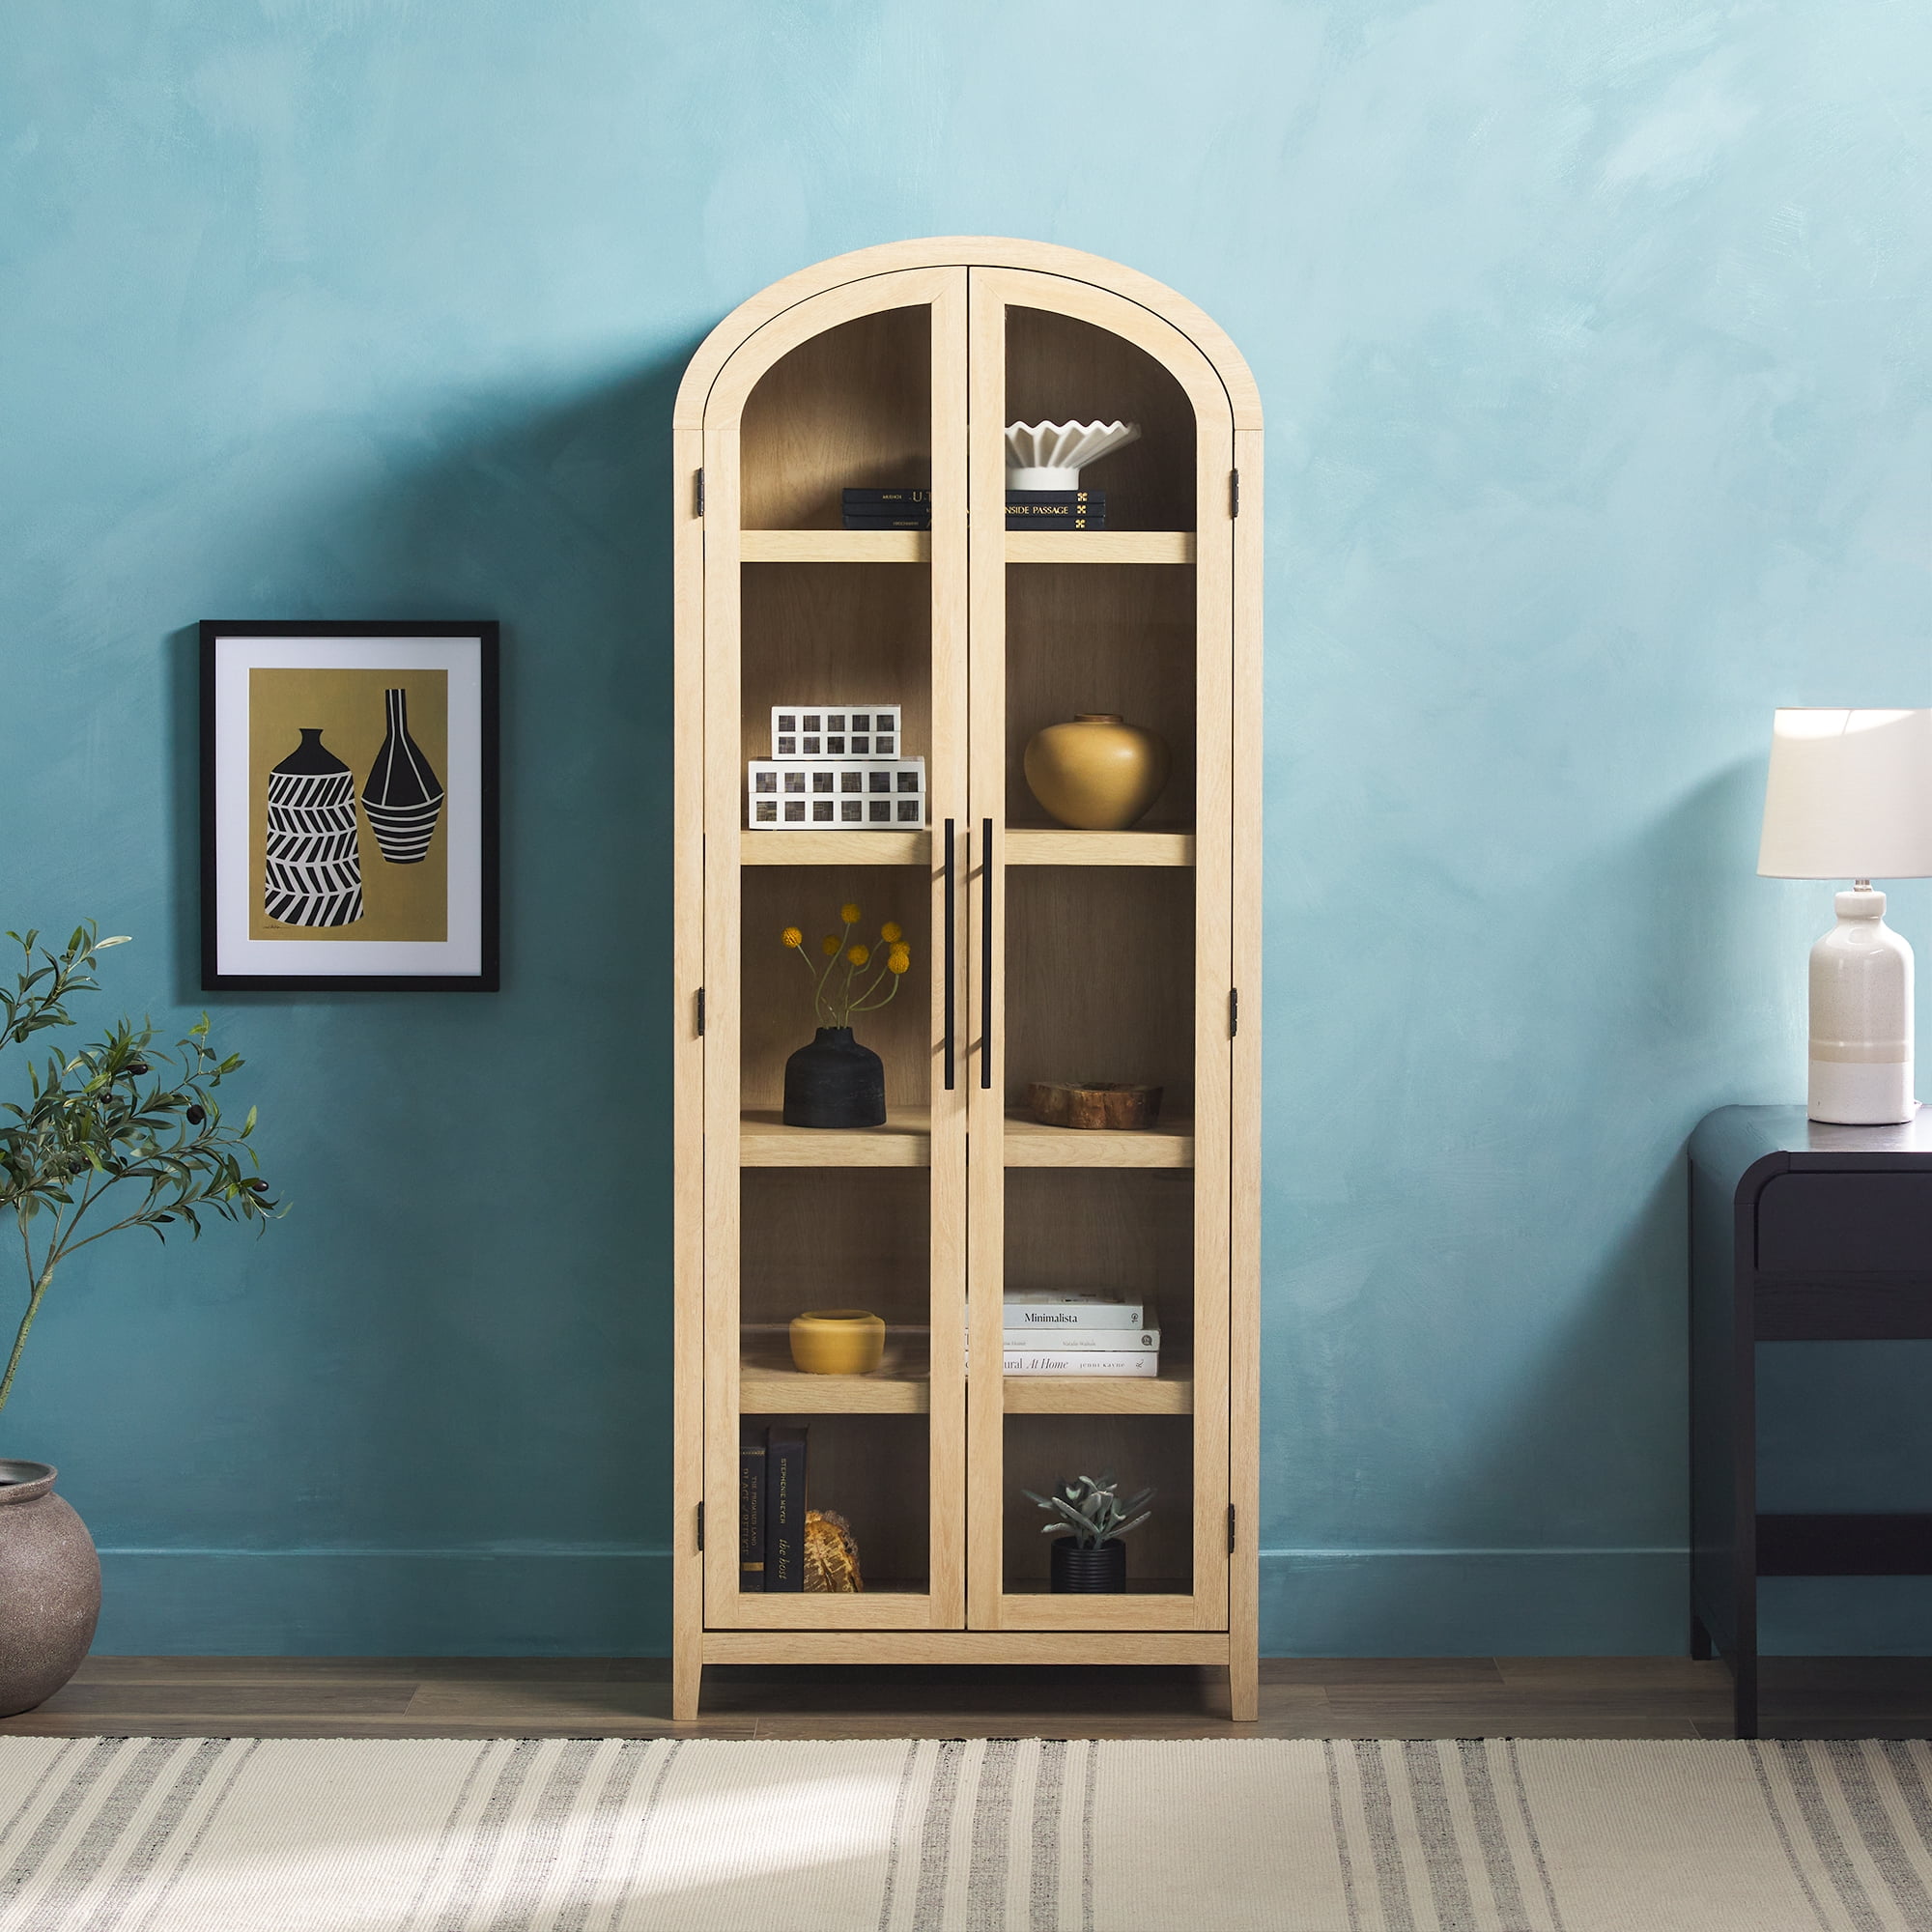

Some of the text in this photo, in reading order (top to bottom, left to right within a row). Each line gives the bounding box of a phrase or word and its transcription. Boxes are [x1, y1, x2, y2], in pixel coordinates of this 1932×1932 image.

[1005, 506, 1069, 515] NSIDE PASSAGE
[1024, 1313, 1078, 1323] Minimalista
[1004, 1357, 1069, 1369] ural At Home
[779, 1539, 790, 1580] the host
